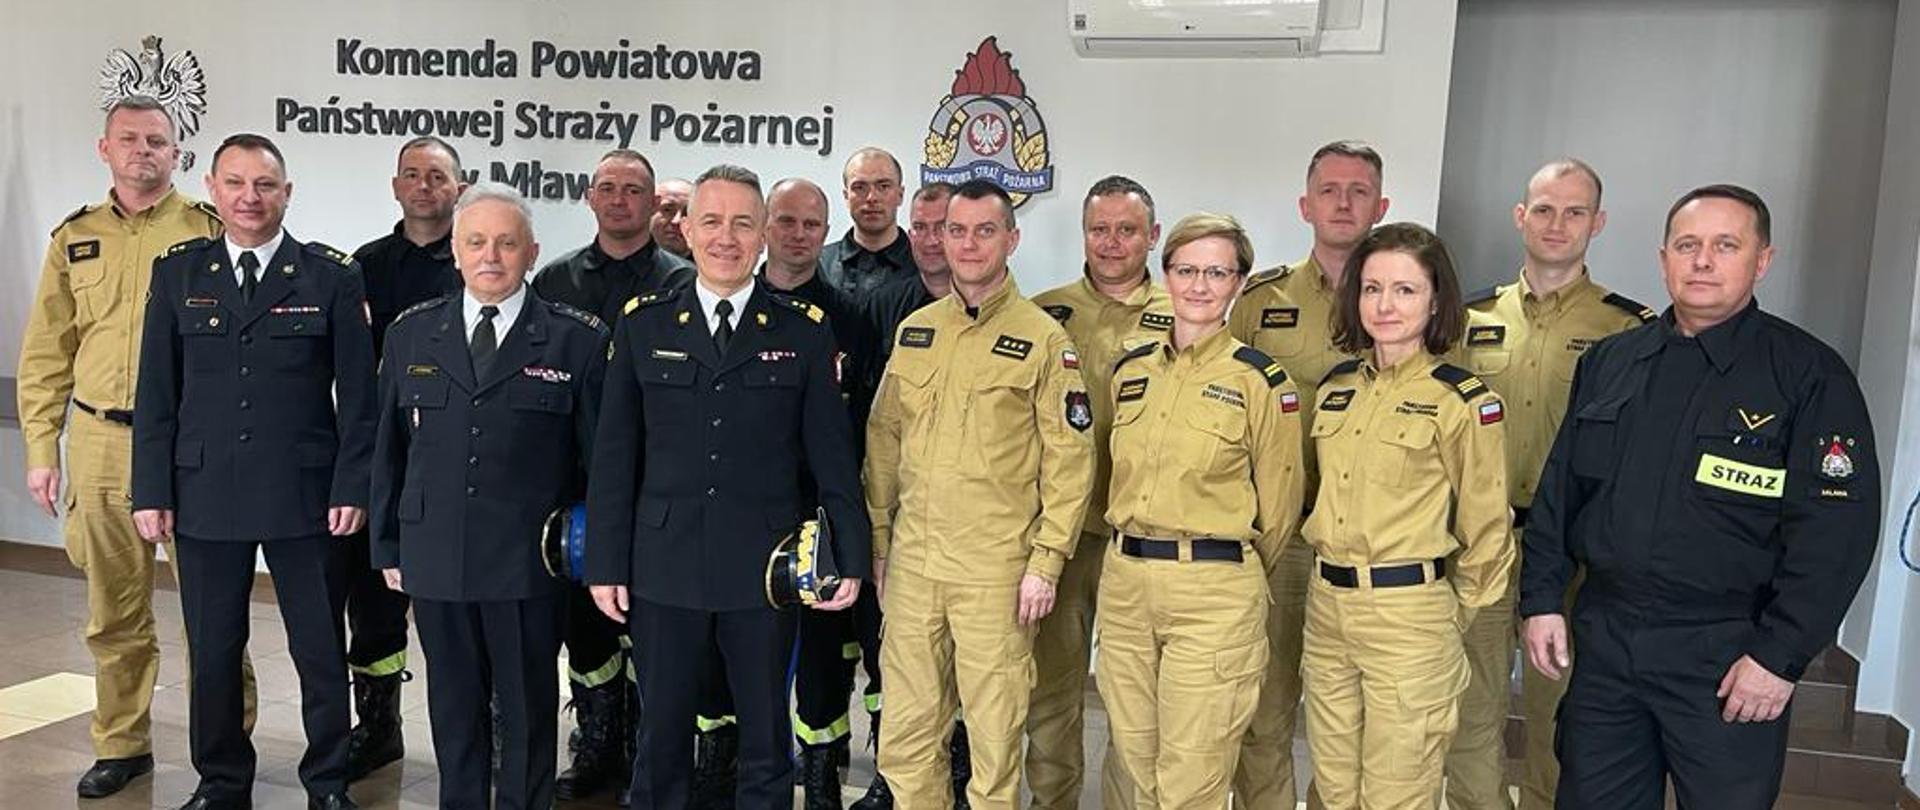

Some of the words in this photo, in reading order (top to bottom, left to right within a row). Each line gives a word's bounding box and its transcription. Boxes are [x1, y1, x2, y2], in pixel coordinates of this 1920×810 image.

[337, 38, 518, 78] Komenda
[531, 39, 762, 80] Powiatowa
[275, 96, 504, 147] Państwowej
[514, 101, 639, 149] Straży
[650, 103, 834, 156] Pożarnej
[490, 159, 598, 200] Mław
